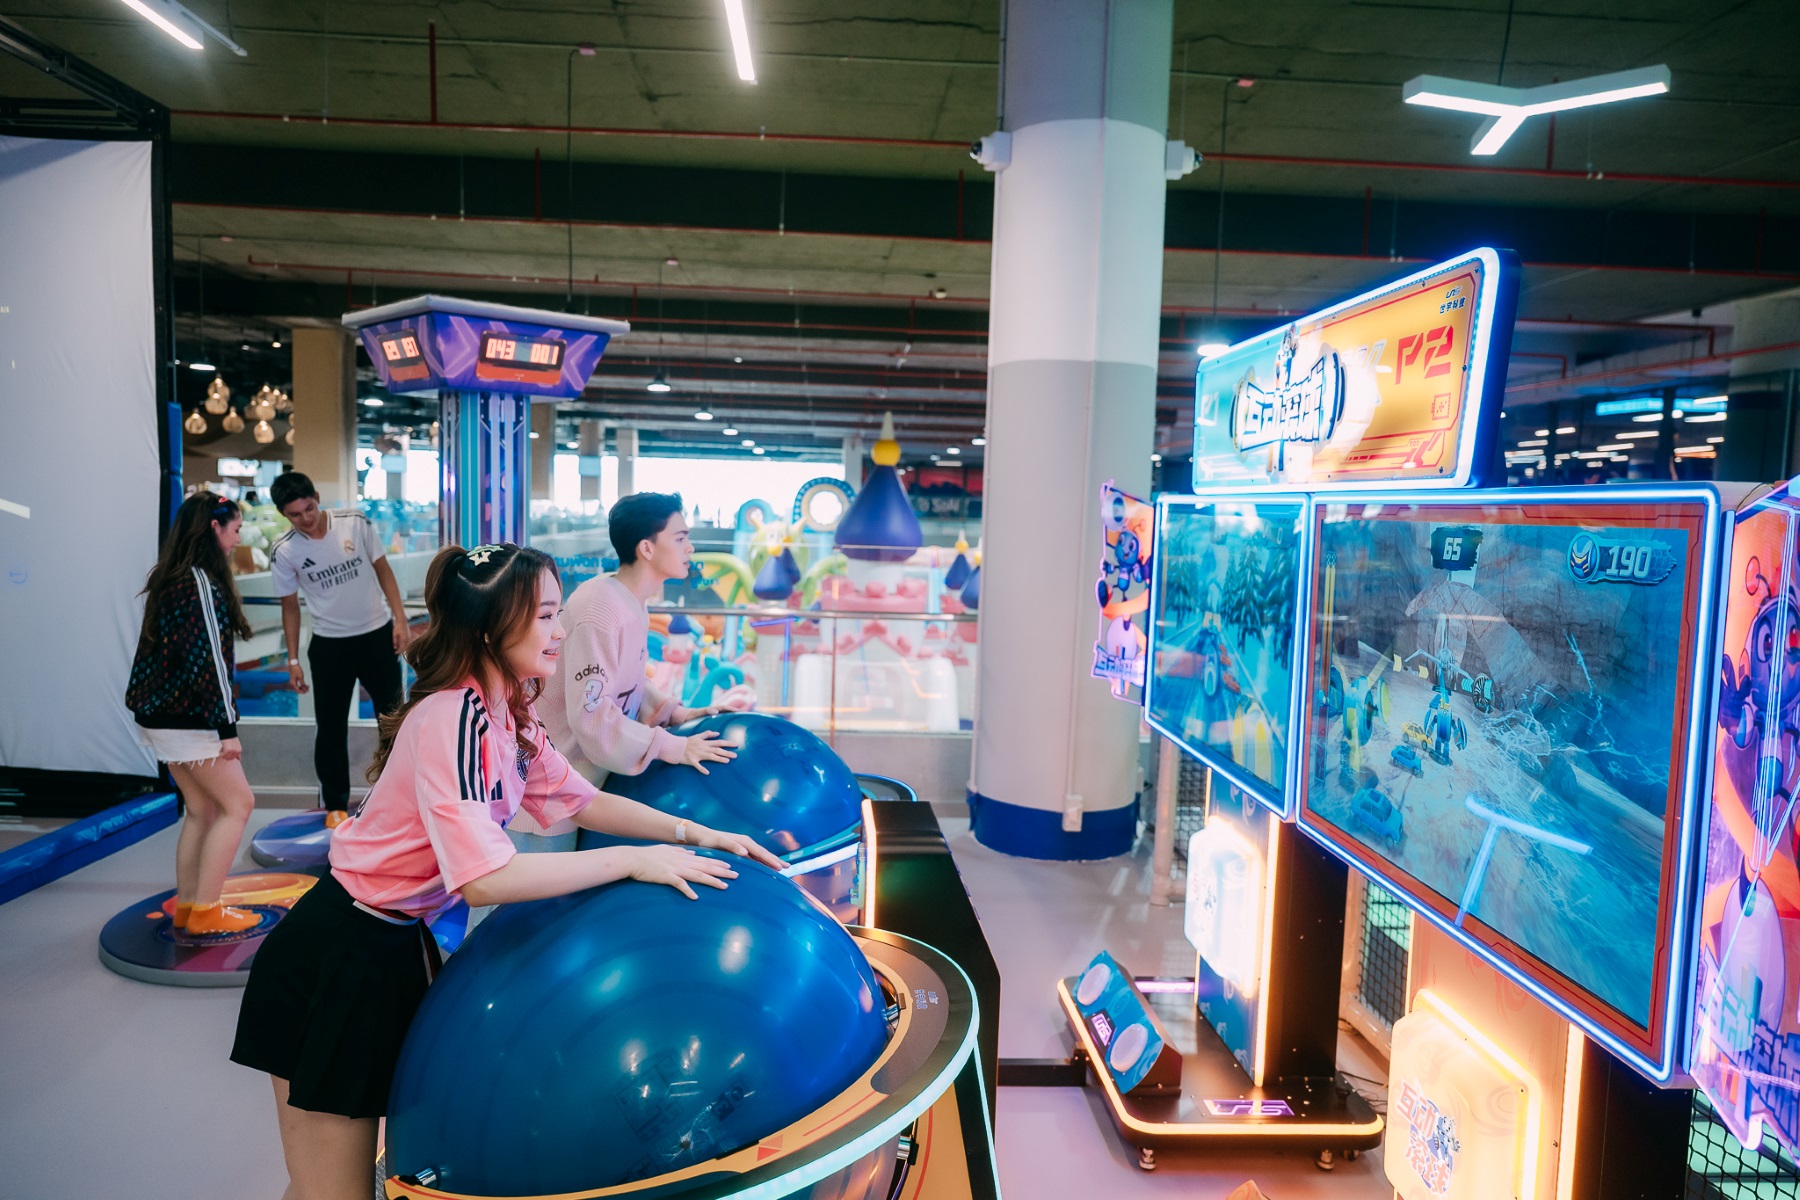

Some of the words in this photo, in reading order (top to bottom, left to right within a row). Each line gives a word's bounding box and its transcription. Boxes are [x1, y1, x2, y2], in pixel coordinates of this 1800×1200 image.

[485, 338, 516, 359] 043
[529, 344, 559, 365] 001
[1395, 325, 1454, 385] P2
[1442, 537, 1463, 561] 65
[1605, 545, 1651, 579] 190
[307, 556, 363, 583] Emirates
[321, 578, 333, 590] FLY
[335, 568, 359, 586] BETTER
